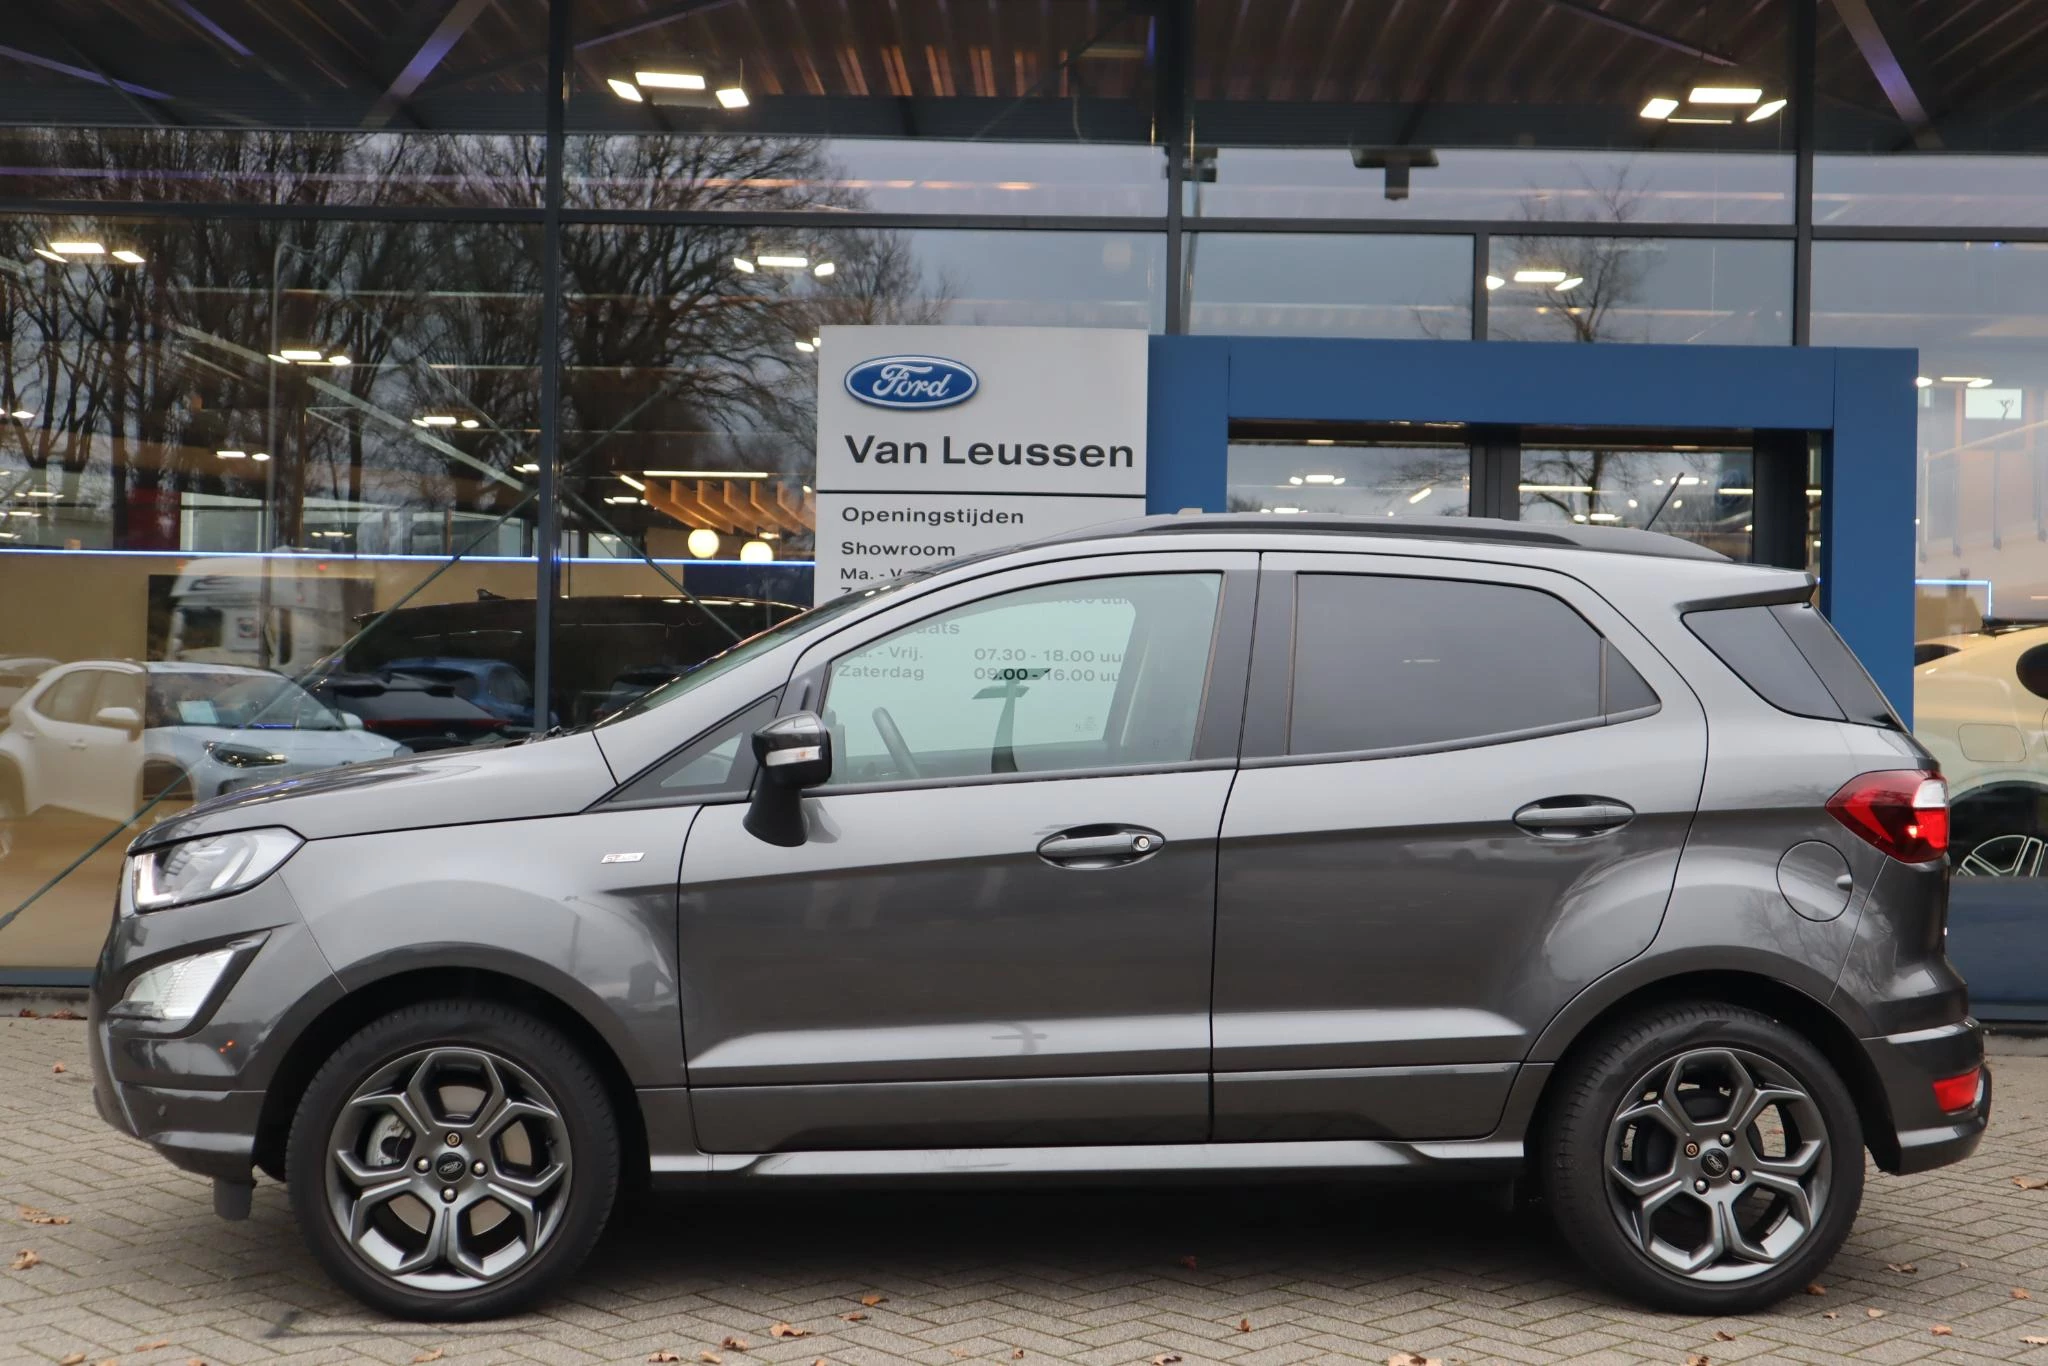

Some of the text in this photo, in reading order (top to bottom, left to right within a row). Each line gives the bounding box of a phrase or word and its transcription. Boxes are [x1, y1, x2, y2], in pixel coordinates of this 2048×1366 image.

[872, 363, 953, 398] Ford
[844, 434, 1134, 468] Van Leussen
[841, 506, 1025, 527] Openingstijden
[841, 541, 956, 557] Showroom
[840, 567, 874, 581] Ma.
[889, 646, 923, 662] Vrij.
[974, 648, 1026, 662] 07.30
[1043, 650, 1095, 663] 18.00
[1100, 653, 1122, 663] uu
[838, 664, 925, 681] Zaterdag
[974, 667, 1029, 681] 09.00
[1045, 668, 1096, 682] 16.00
